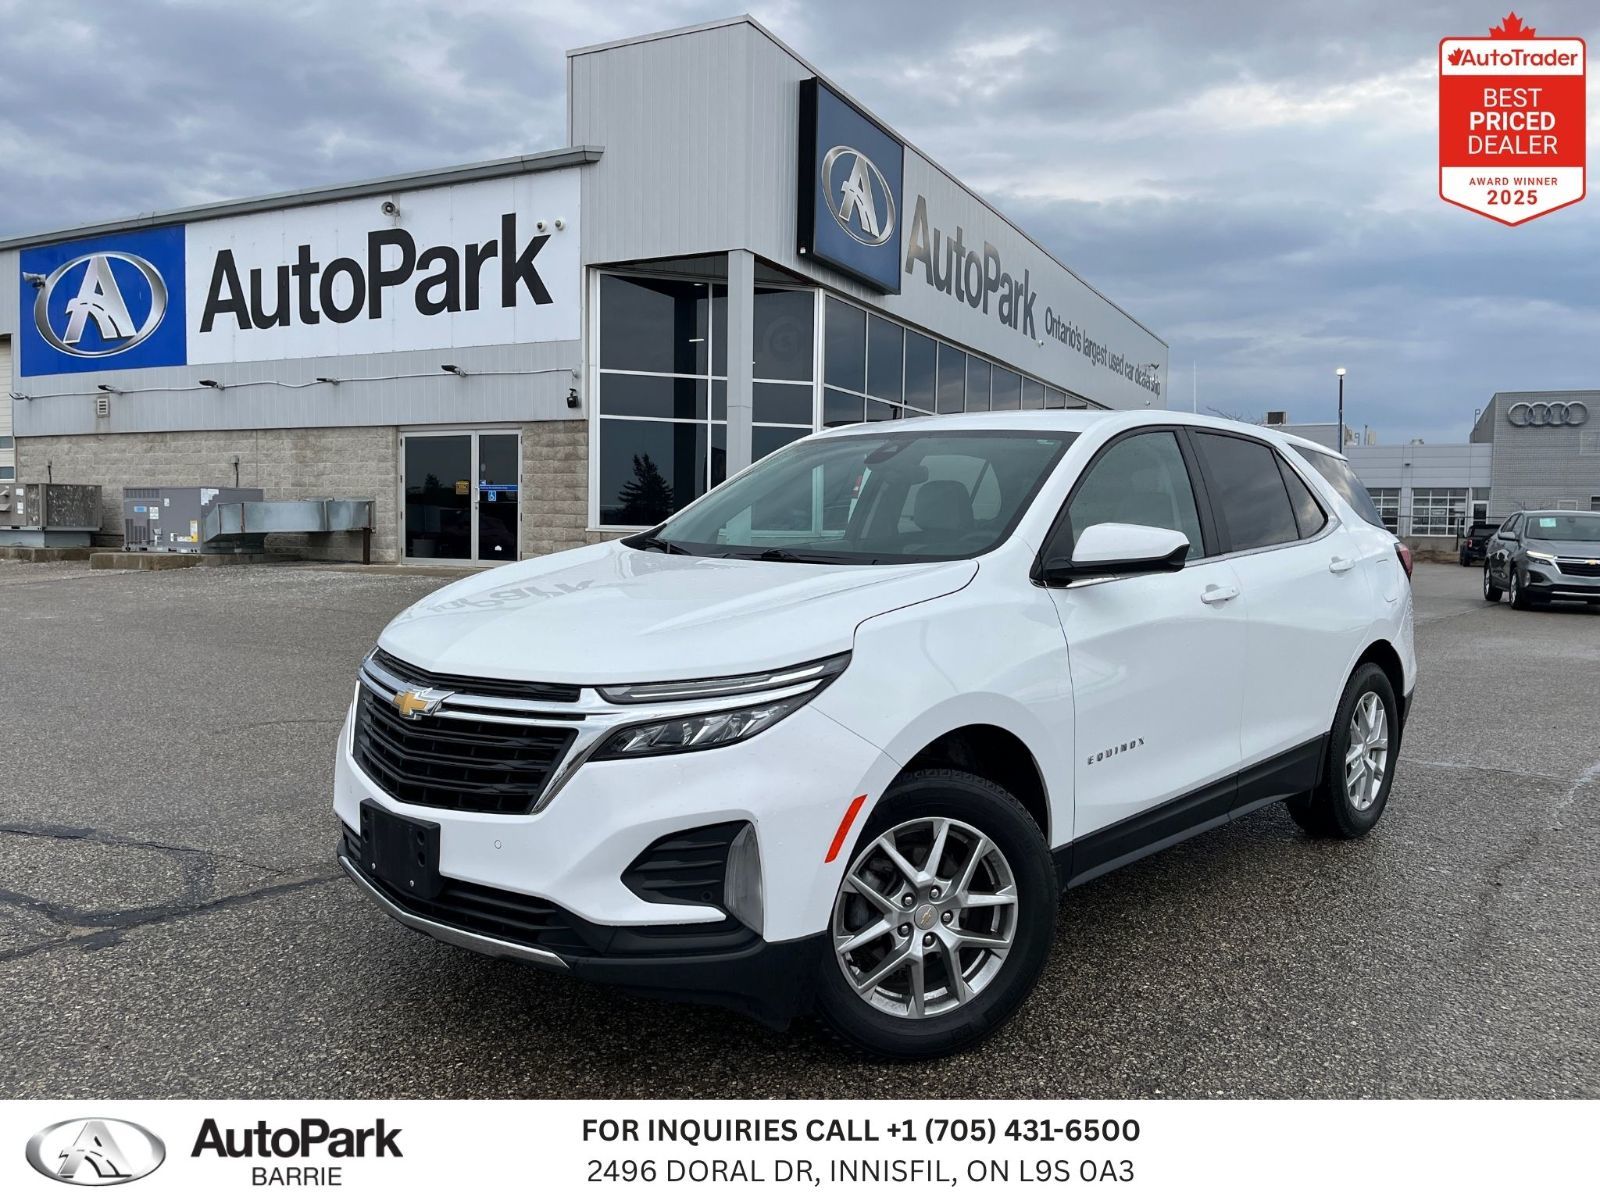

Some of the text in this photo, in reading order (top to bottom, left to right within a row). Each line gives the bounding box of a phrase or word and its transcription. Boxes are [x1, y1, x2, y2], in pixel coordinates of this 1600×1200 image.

[200, 213, 553, 333] AutoPark
[905, 194, 1037, 341] AutoPark
[1045, 306, 1081, 352] Ontario's
[1083, 329, 1107, 367] largest
[1109, 352, 1124, 376] used
[1125, 361, 1135, 381] car
[1087, 736, 1145, 766] EQUINOX
